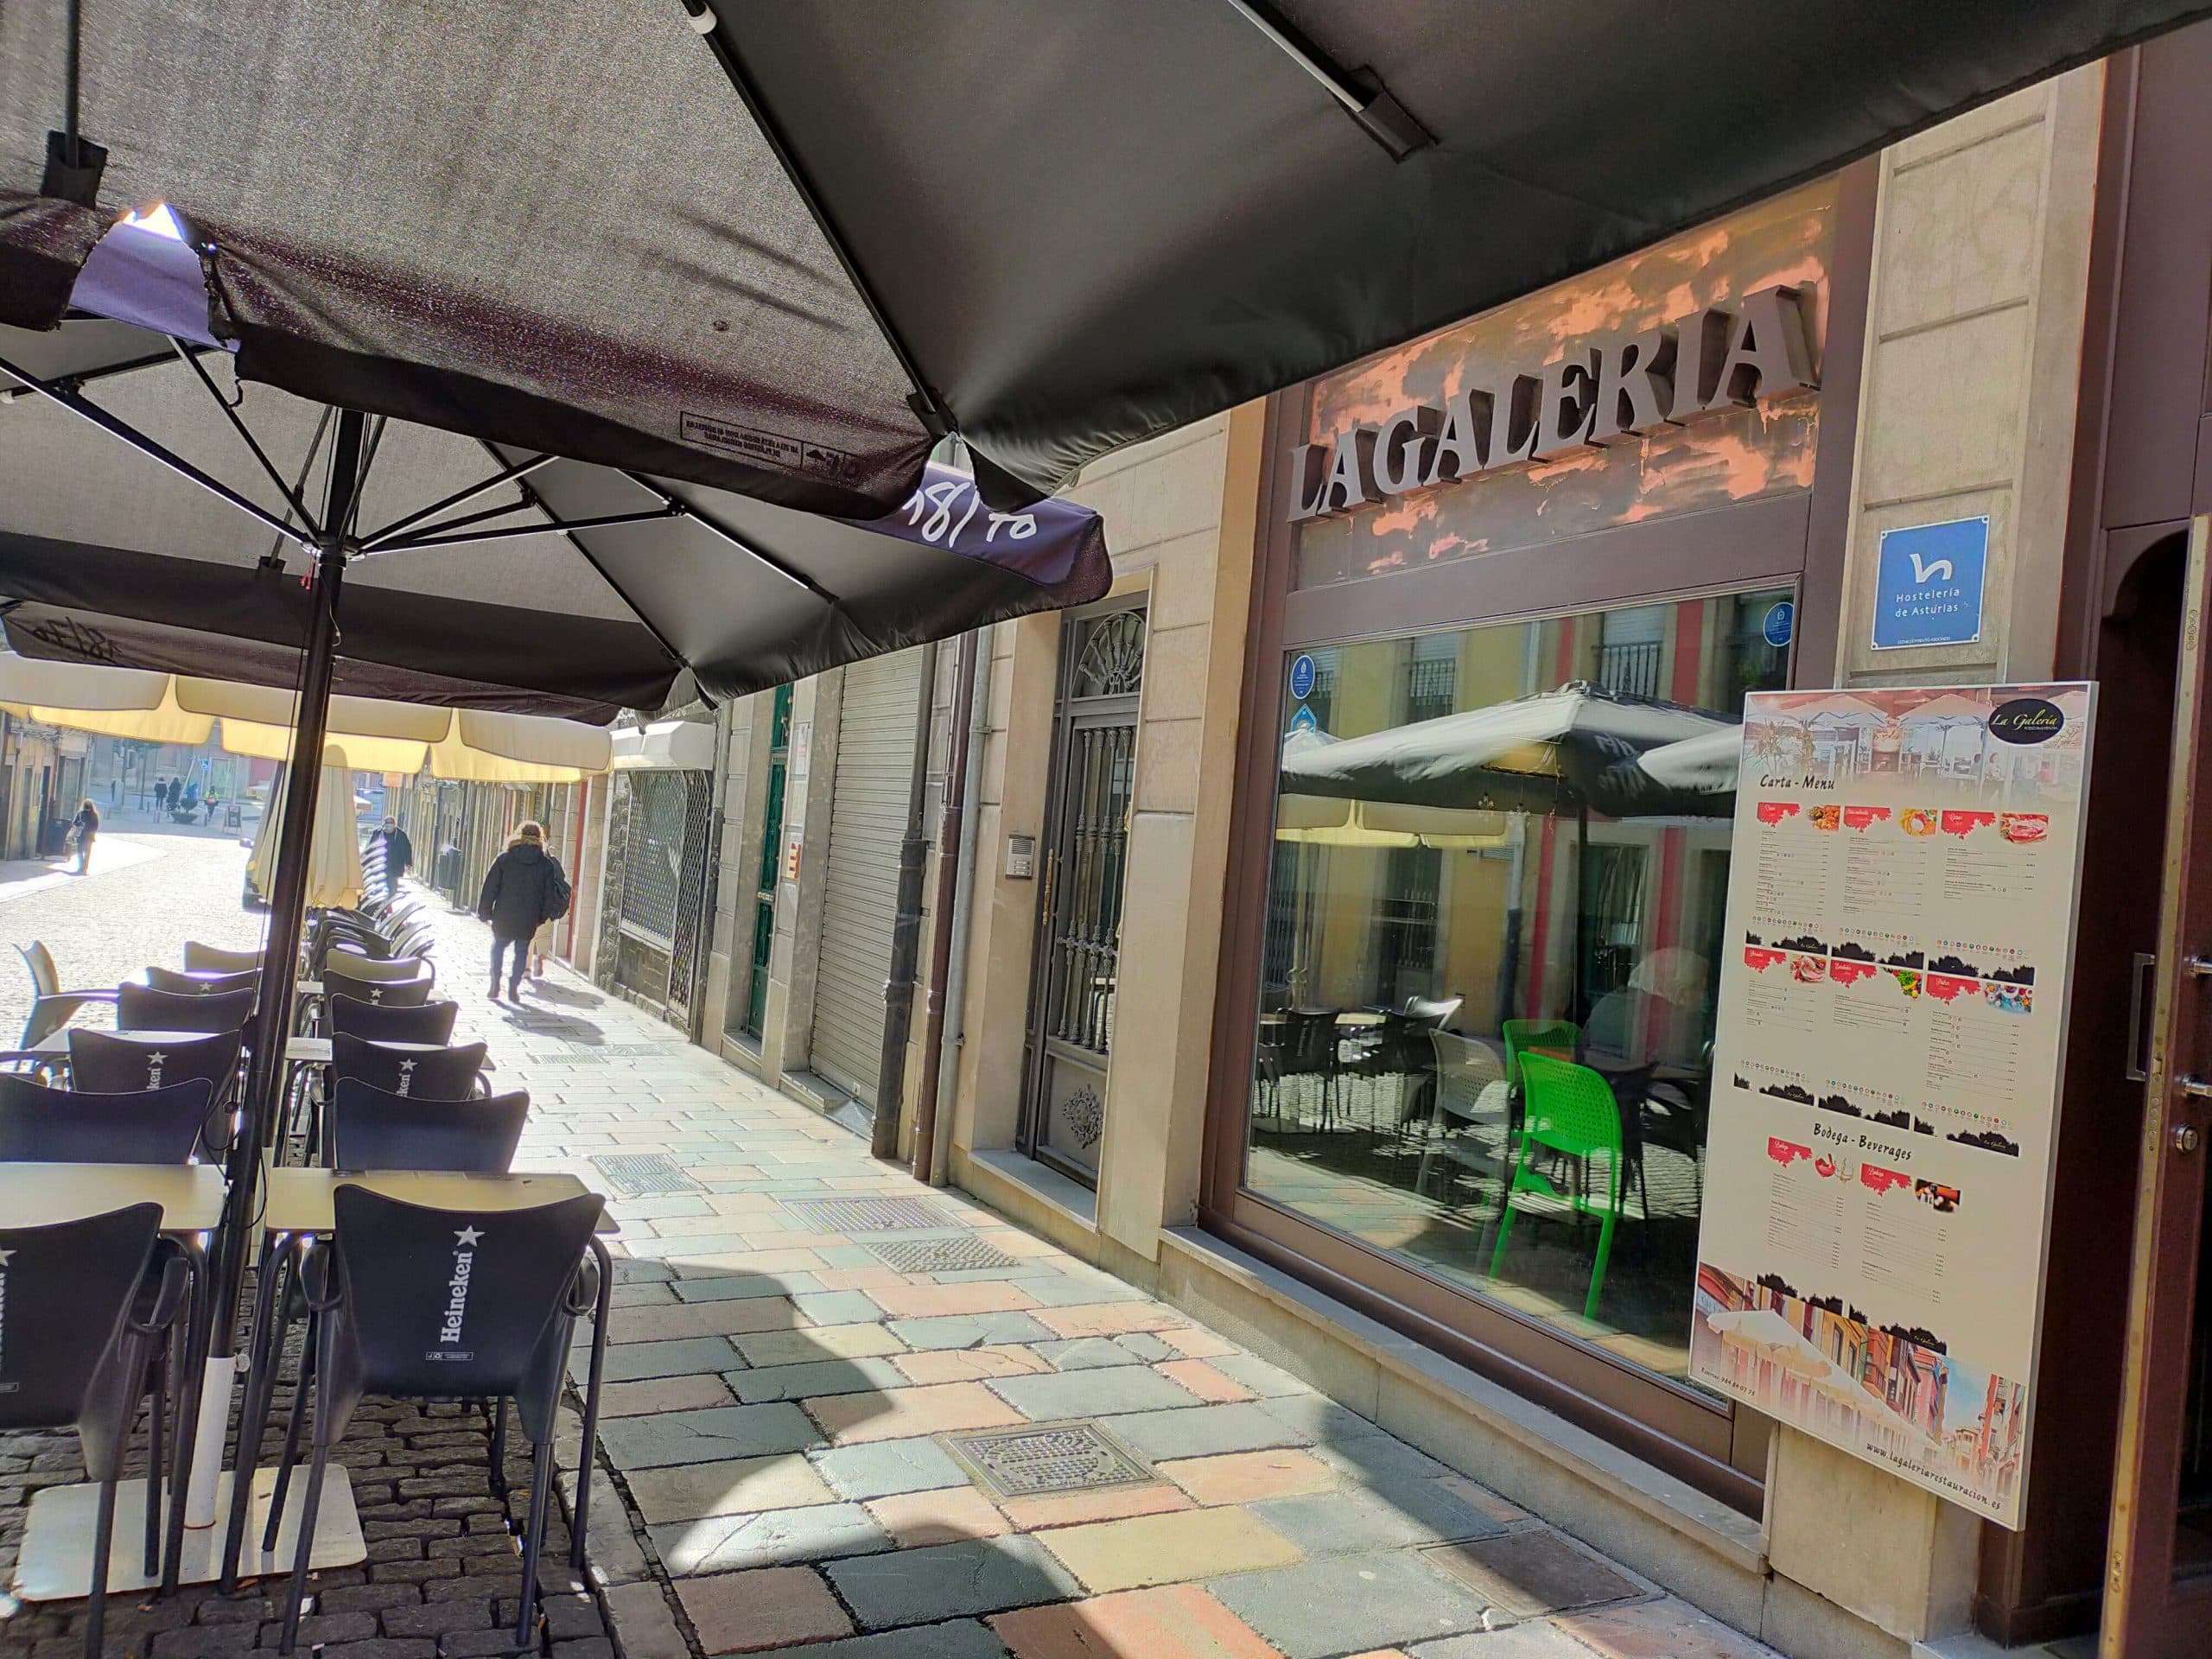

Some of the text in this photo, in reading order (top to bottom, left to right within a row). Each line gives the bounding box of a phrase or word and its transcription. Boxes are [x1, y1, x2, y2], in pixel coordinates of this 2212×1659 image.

[1895, 603, 1959, 618] de Asturias
[1990, 714, 2009, 726] La
[1759, 773, 1791, 788] Carta
[1802, 775, 1835, 790] Menu
[1814, 1122, 1848, 1146] Bodega
[1859, 1135, 1912, 1161] Beverages
[440, 1250, 474, 1343] Heineken
[1866, 1442, 2000, 1510] www.lagaleriarestauracion.es
